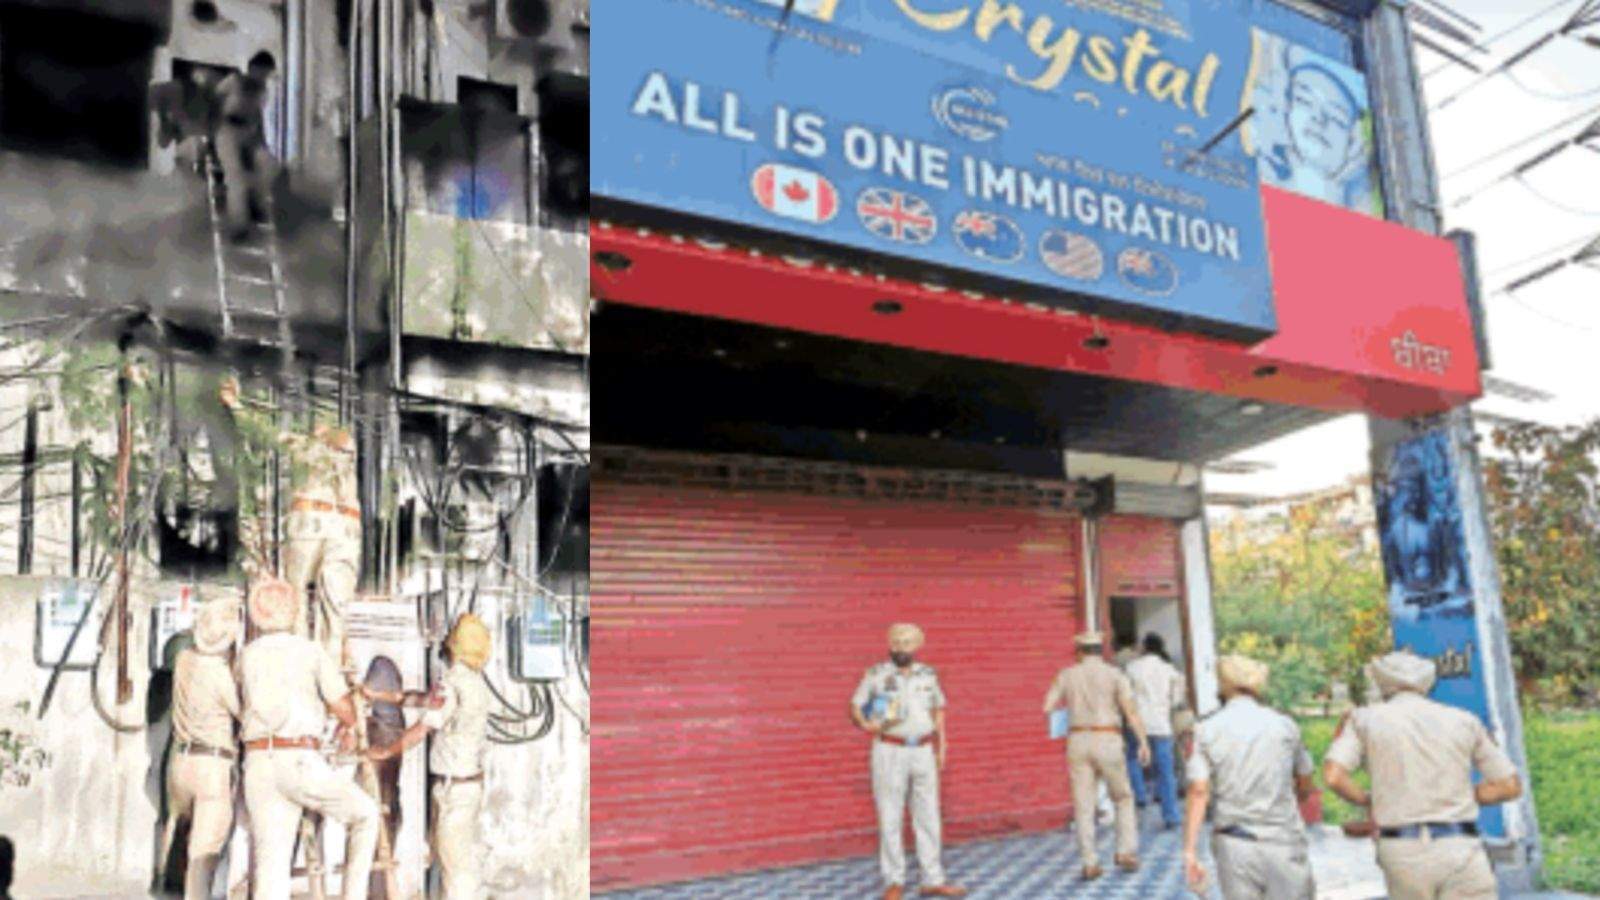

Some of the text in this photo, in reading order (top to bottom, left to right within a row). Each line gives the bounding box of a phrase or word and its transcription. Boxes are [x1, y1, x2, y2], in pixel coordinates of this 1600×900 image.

[631, 71, 756, 142] ALL
[774, 105, 827, 158] IS
[843, 126, 949, 190] ONE
[963, 155, 1240, 261] IMMIGRATION
